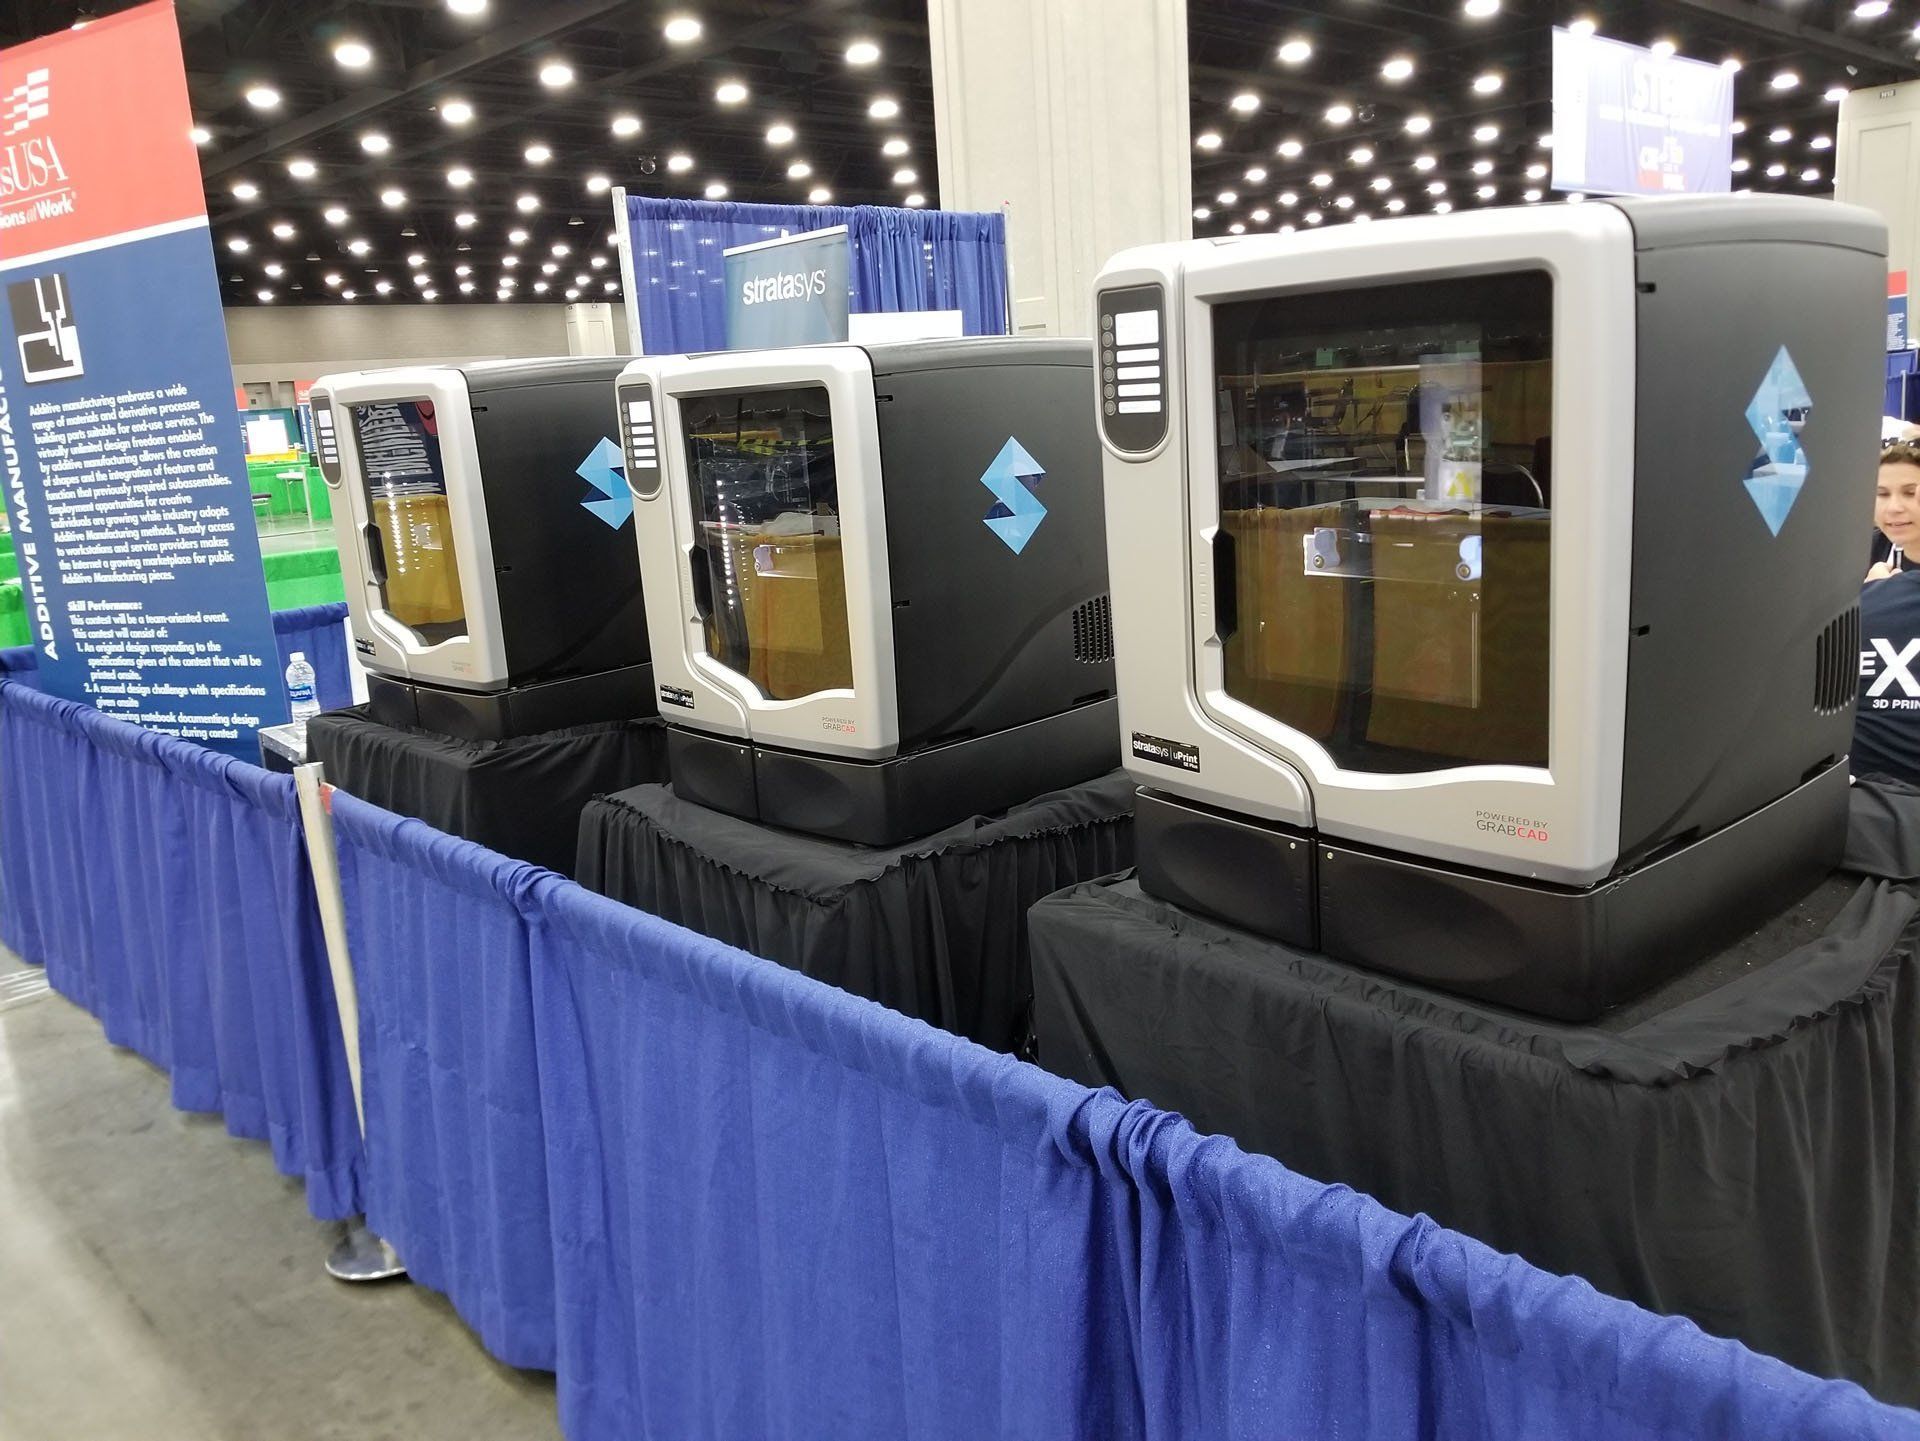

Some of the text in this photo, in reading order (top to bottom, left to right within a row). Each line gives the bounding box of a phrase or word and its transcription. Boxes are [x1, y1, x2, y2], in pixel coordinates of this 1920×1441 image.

[0, 135, 69, 196] sUSA
[742, 269, 826, 305] stratasys
[30, 403, 61, 416] Additive
[62, 395, 116, 411] manufacturing
[117, 390, 155, 404] embraces
[165, 384, 187, 396] wide
[32, 401, 200, 430] range of materials and derivative processes
[34, 412, 214, 444] building parts suitable for end-use service. The
[37, 429, 203, 458] virtually unlimited design freedom enabled
[39, 445, 217, 474] by additive manufacturing allows the creation
[43, 459, 214, 487] of shapes and the integration of feature and
[45, 474, 231, 500] function that previously required subassemblies.
[0, 367, 59, 661] ADDITIVE MANUFAC
[48, 494, 192, 515] Employment opportunities for creative
[51, 506, 229, 529] individuals are growing while industry adopts
[54, 522, 235, 542] Additive Manufacturing methods. Ready access
[57, 536, 228, 556] to workstations and service providers makes
[59, 551, 234, 570] the Internet a growing marketplace for public
[62, 570, 174, 584] Additive Manufacturing pieces.
[68, 600, 142, 611] Skill Performance:
[69, 615, 84, 625] This
[85, 616, 111, 624] contest
[113, 614, 126, 624] will
[127, 614, 137, 624] be
[146, 612, 201, 624] team-oriented
[203, 613, 229, 622] event.
[72, 627, 168, 639] This contest will consist of:
[76, 641, 221, 654] 1. An original design responding to the
[88, 655, 261, 668] specifications given at the contest that will be
[90, 670, 141, 681] printed onsite.
[83, 683, 266, 697] 2. A second design challenge with specifications
[96, 697, 139, 708] given onsite
[1872, 698, 1889, 709] 3D
[141, 712, 176, 724] notebook
[178, 712, 230, 726] documenting
[232, 714, 259, 726] design
[823, 722, 856, 733] GRABCAD
[182, 727, 207, 740] during
[209, 728, 238, 738] contest
[1133, 740, 1198, 764] stratasys uPrint
[1476, 810, 1548, 829] POWERED BY
[1476, 819, 1548, 841] GRABCAD
